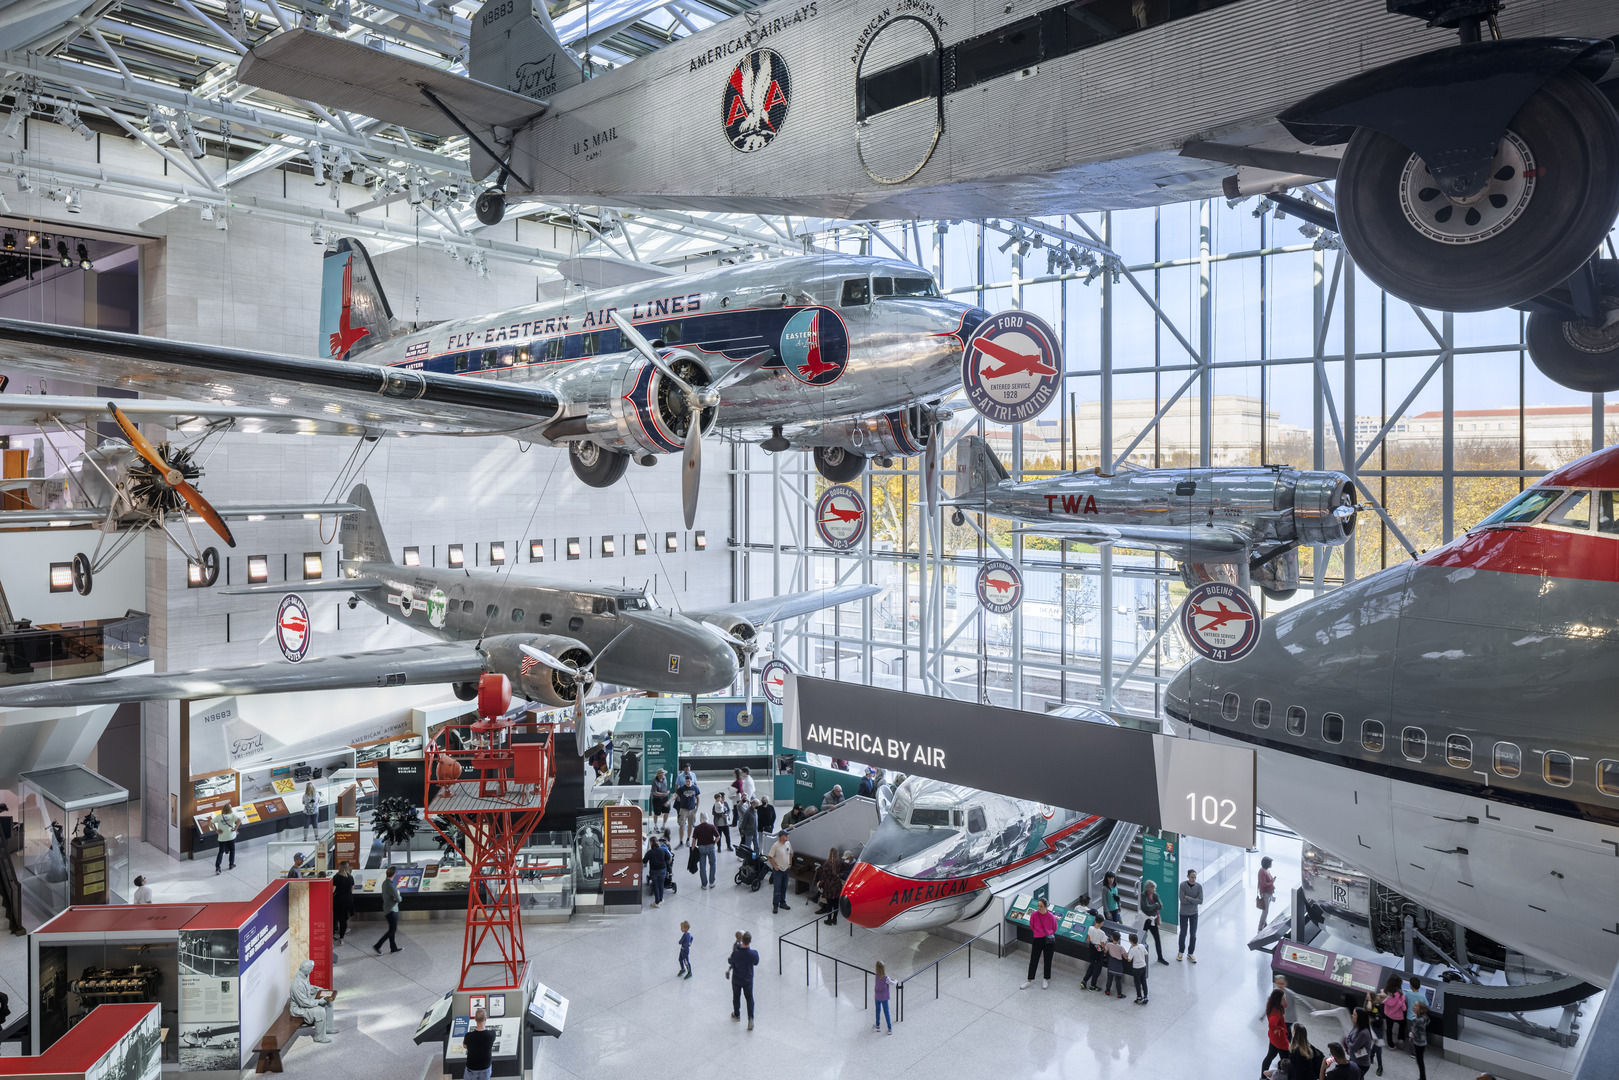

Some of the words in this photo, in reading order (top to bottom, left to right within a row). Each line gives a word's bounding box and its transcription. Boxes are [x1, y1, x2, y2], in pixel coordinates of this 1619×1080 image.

[689, 30, 755, 72] AMERICAN
[759, 2, 818, 39] AIRWAYS
[850, 8, 891, 64] AMERICAN
[512, 53, 557, 93] Ford
[592, 127, 618, 147] MAIL
[447, 332, 473, 349] FLY
[485, 315, 569, 343] EASTERN
[582, 307, 618, 328] AIR
[632, 292, 702, 320] LINES
[998, 316, 1024, 330] FORD
[786, 331, 817, 340] EASTERN
[972, 387, 994, 412] 5-AT
[994, 385, 1052, 420] TRI-MOTOR
[829, 488, 852, 497] DOUGLAS
[1044, 494, 1098, 514] TWA
[833, 540, 848, 548] DC-3
[1206, 586, 1234, 596] BOEING
[994, 604, 1012, 612] ALPHA
[1213, 648, 1226, 659] 747
[204, 710, 231, 723] N9683
[351, 731, 380, 744] AMERICAN
[384, 721, 408, 733] AIRWAYS
[231, 734, 263, 754] Ford
[234, 747, 264, 759] TRI-MOTOR
[807, 724, 884, 756] AMERICA
[888, 738, 911, 761] BY
[913, 745, 946, 769] AIR
[796, 779, 813, 788] ENTRANCE
[1186, 792, 1236, 829] 102
[889, 878, 968, 906] AMERICAN
[314, 922, 325, 941] FLY
